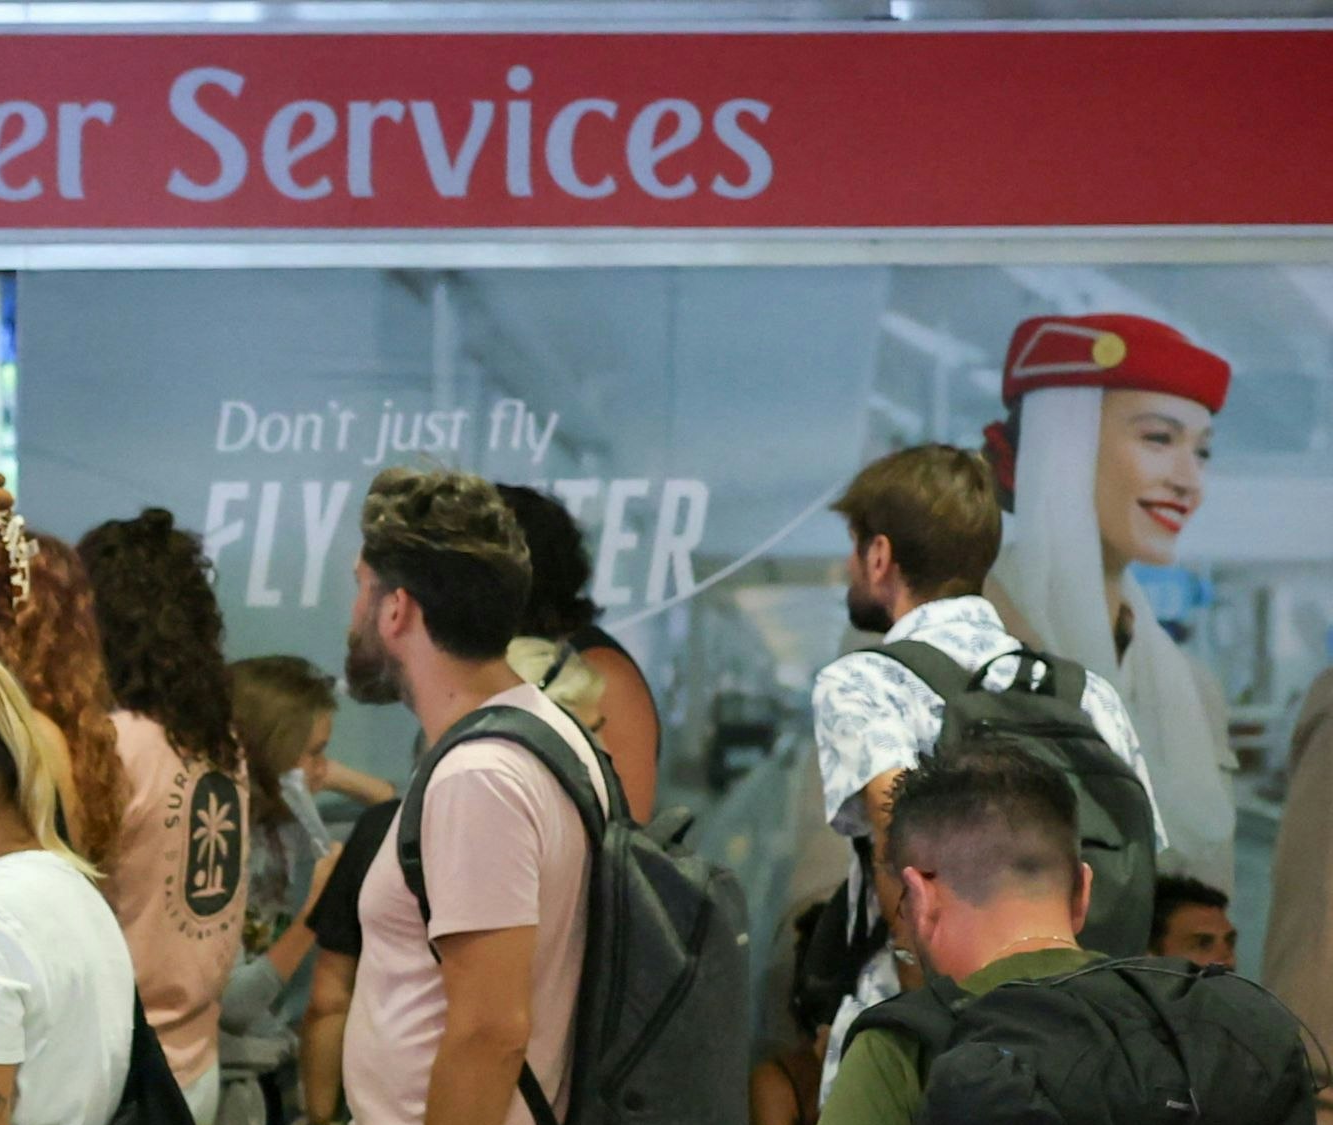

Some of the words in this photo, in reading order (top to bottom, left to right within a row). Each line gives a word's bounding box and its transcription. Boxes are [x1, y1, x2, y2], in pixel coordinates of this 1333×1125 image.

[167, 66, 773, 202] Services
[215, 400, 355, 453] Don't
[363, 400, 469, 466] just
[488, 398, 560, 463] fly
[203, 481, 351, 607] FLY
